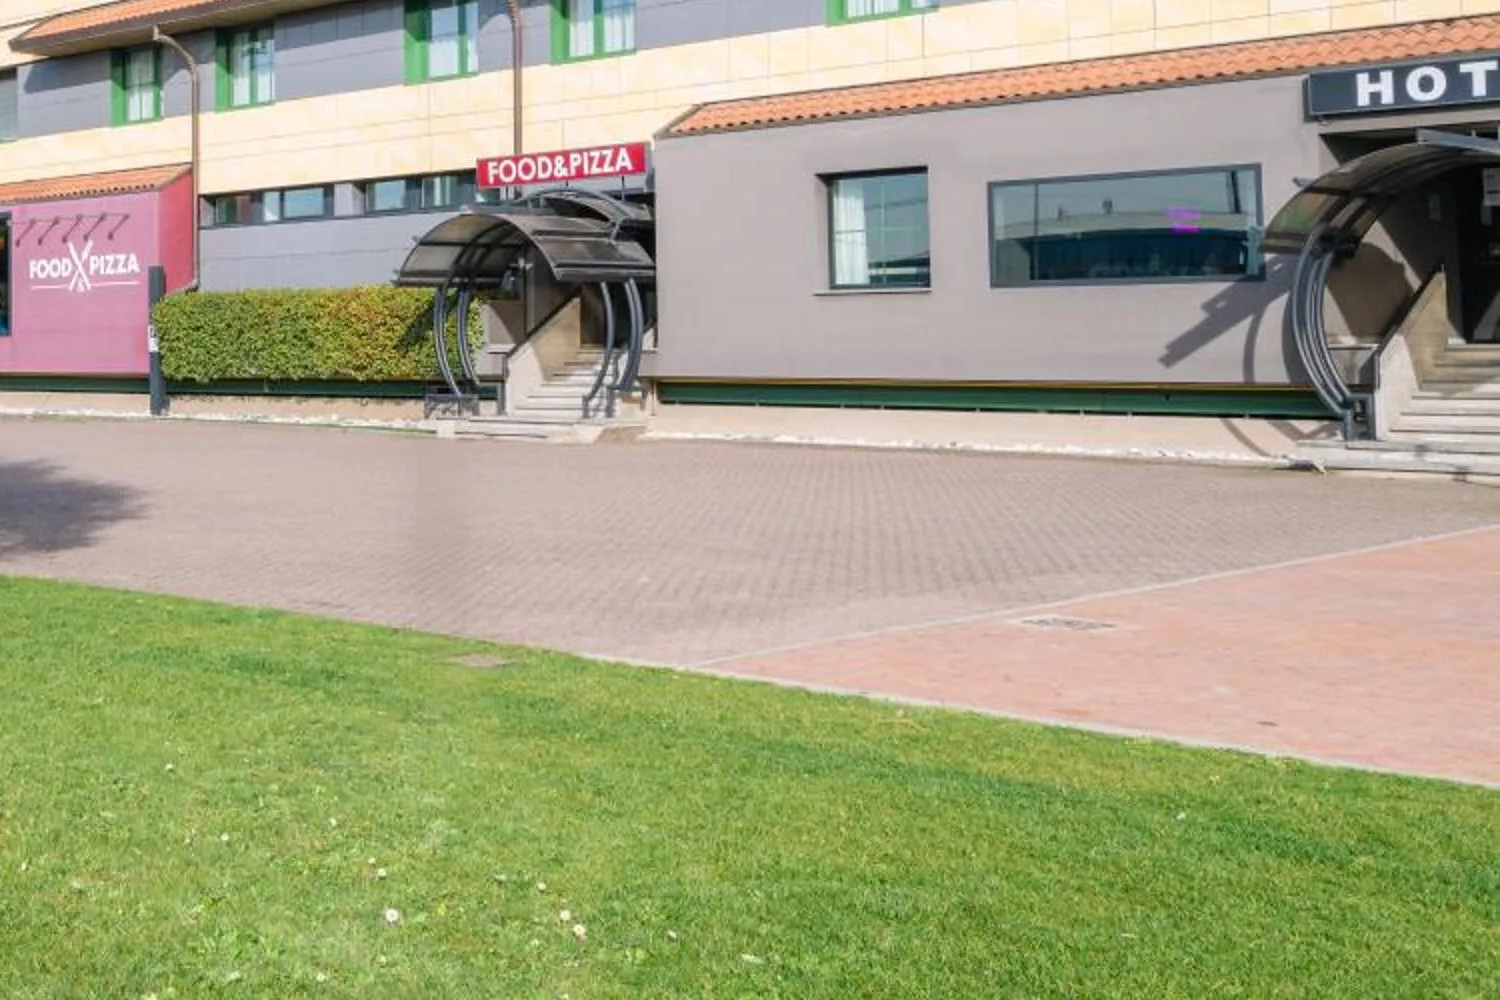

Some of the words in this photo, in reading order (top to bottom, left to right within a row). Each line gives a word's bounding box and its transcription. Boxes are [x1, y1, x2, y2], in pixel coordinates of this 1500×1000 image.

[1355, 60, 1499, 107] HOT
[487, 146, 633, 185] FOOD&PIZZA
[29, 257, 73, 279] FOOD
[89, 253, 140, 276] PIZZA
